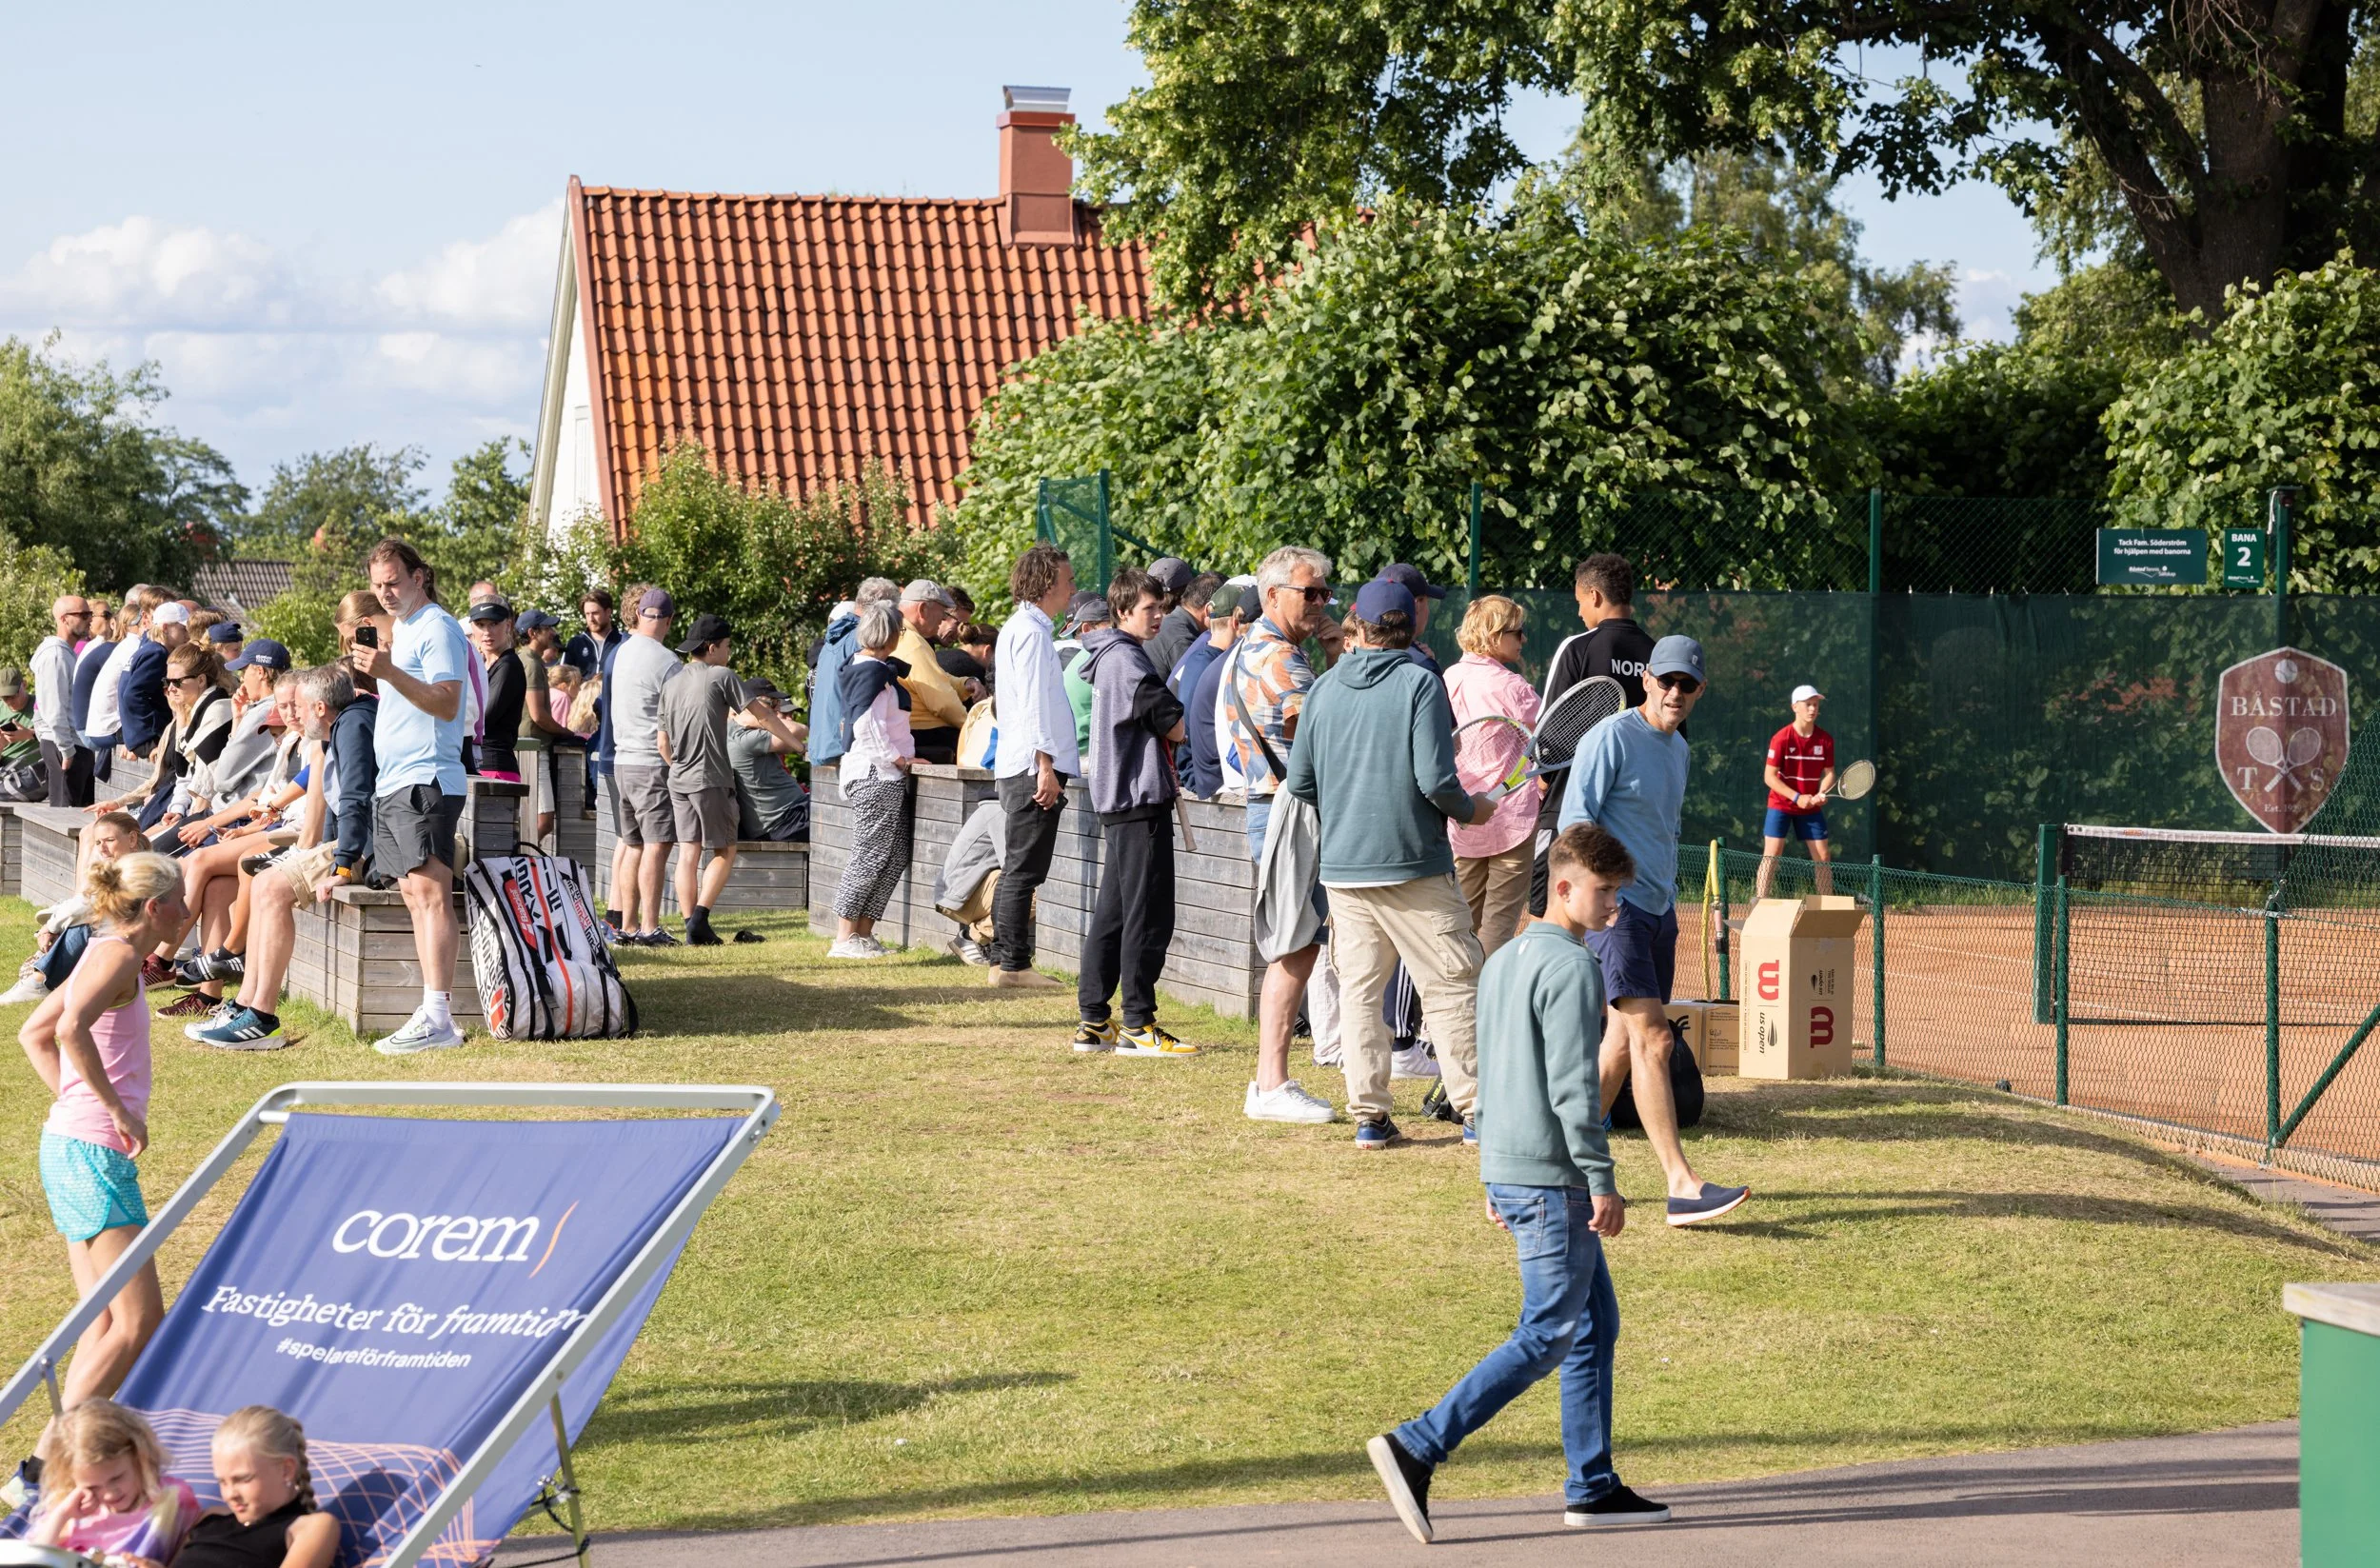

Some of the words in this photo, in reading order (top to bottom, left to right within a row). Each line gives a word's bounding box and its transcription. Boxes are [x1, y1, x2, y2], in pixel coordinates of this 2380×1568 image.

[2150, 538, 2187, 546] Söderström
[2231, 533, 2257, 543] BANA
[2124, 547, 2148, 557] hjälpen
[2236, 546, 2251, 567] 2
[1611, 658, 1649, 678] NOR
[2231, 690, 2337, 717] BÅSTAD
[2237, 766, 2258, 790] T
[2310, 767, 2325, 792] S
[2264, 804, 2282, 813] Est.
[509, 887, 529, 923] Babolat
[1759, 1012, 1766, 1025] us
[1757, 1026, 1766, 1054] open
[332, 1209, 541, 1262] corem
[201, 1284, 383, 1332] Fastigheter
[382, 1302, 437, 1334] för
[275, 1337, 472, 1369] #spelareförframtiden
